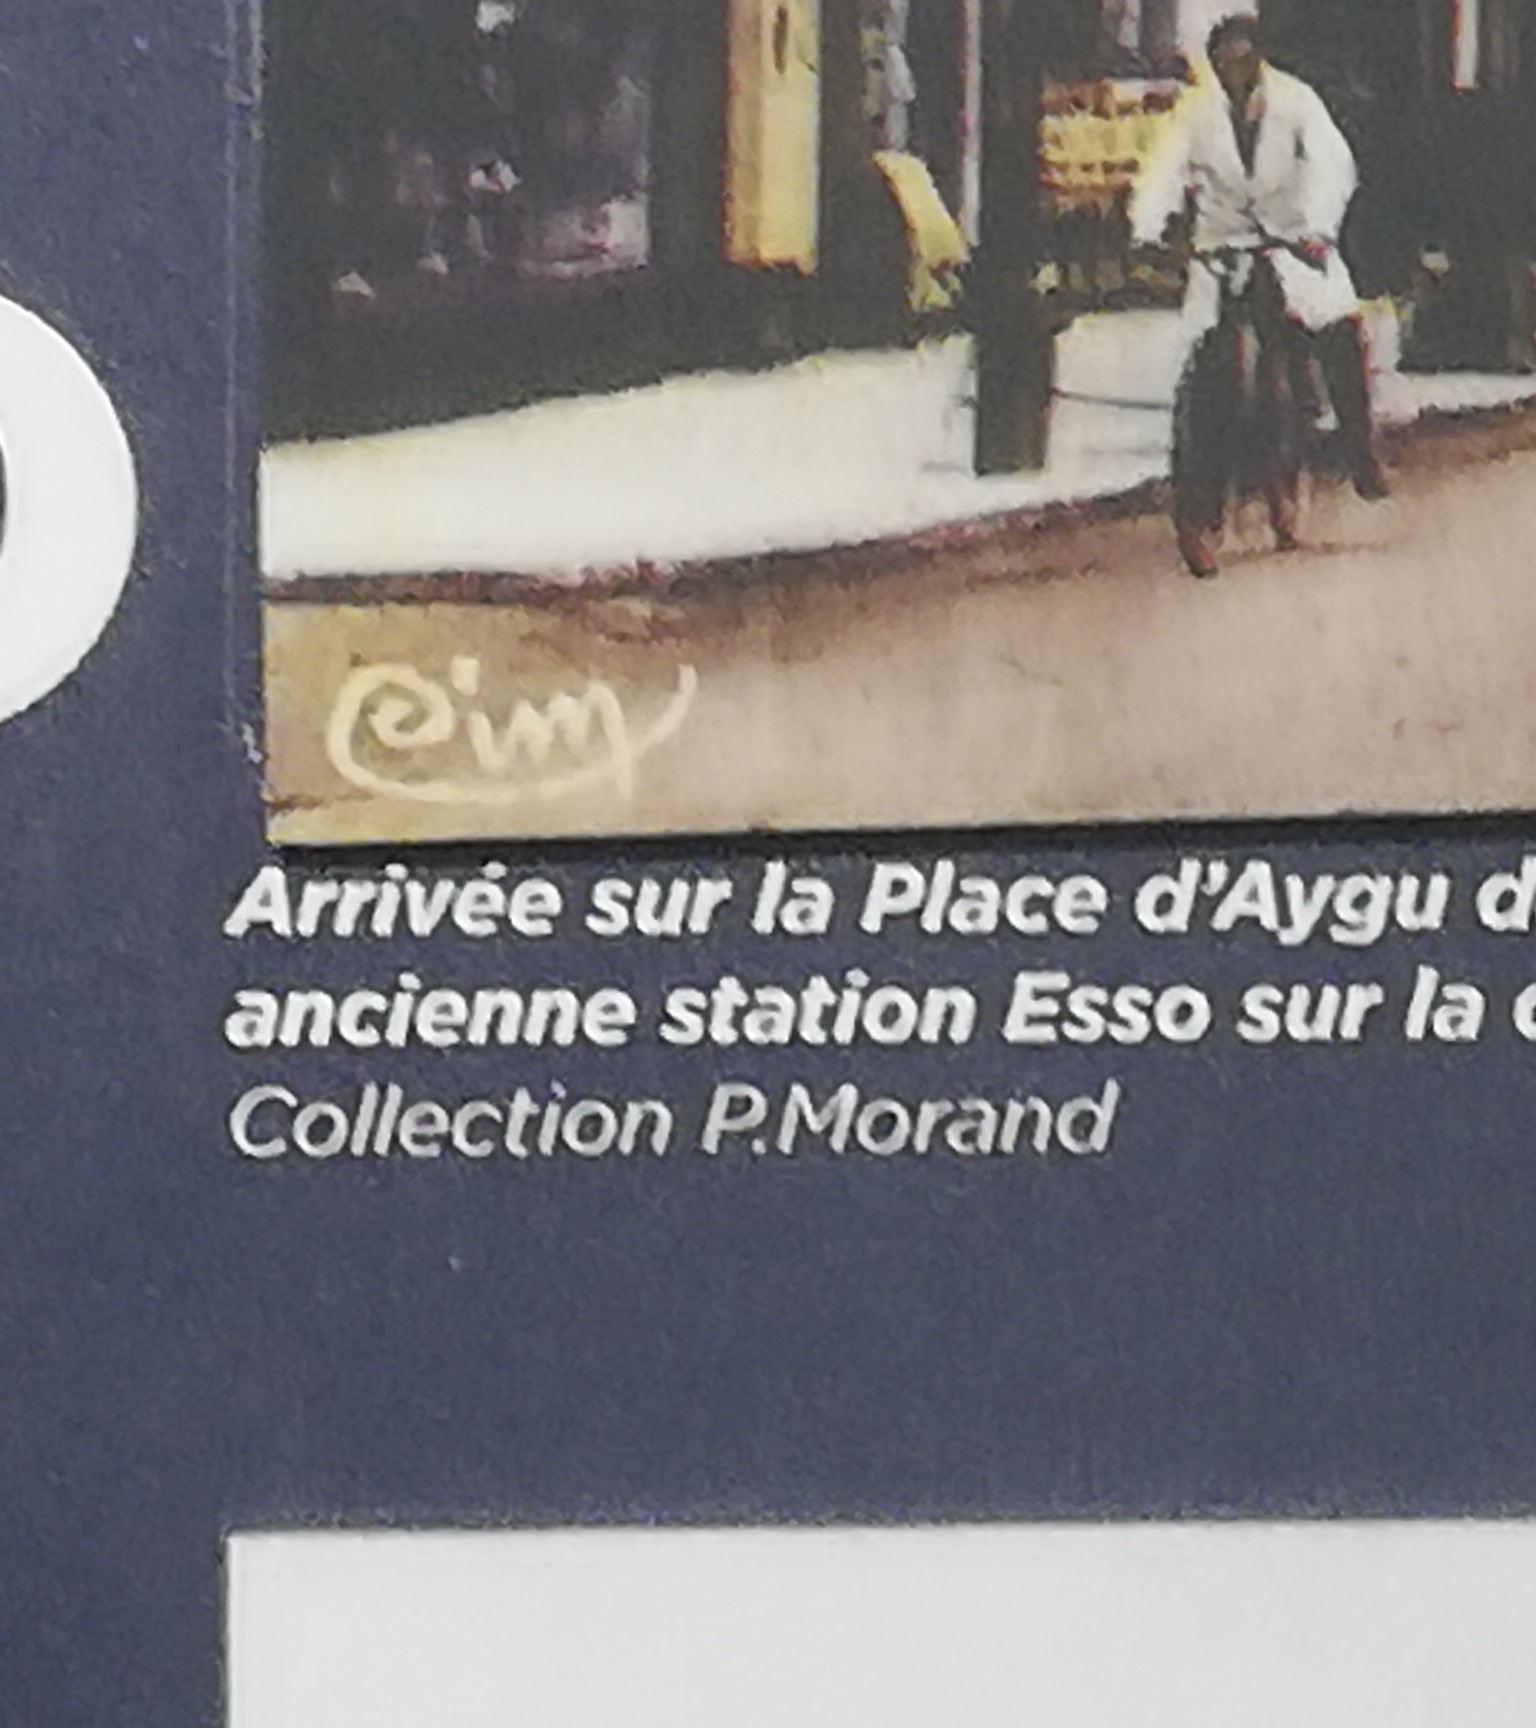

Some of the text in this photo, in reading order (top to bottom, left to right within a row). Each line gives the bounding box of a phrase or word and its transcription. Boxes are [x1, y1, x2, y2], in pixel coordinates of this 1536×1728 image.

[223, 861, 563, 938] Arrivée
[584, 877, 734, 937] sur
[750, 859, 836, 935] la
[859, 858, 1109, 934] Place
[1134, 857, 1451, 946] d'Aygu
[224, 971, 638, 1048] ancienne
[659, 967, 977, 1046] station
[1001, 970, 1212, 1044] Esso
[1235, 982, 1385, 1043] sur
[1404, 963, 1486, 1042] la
[229, 1078, 1120, 1159] Collection P.Morand
